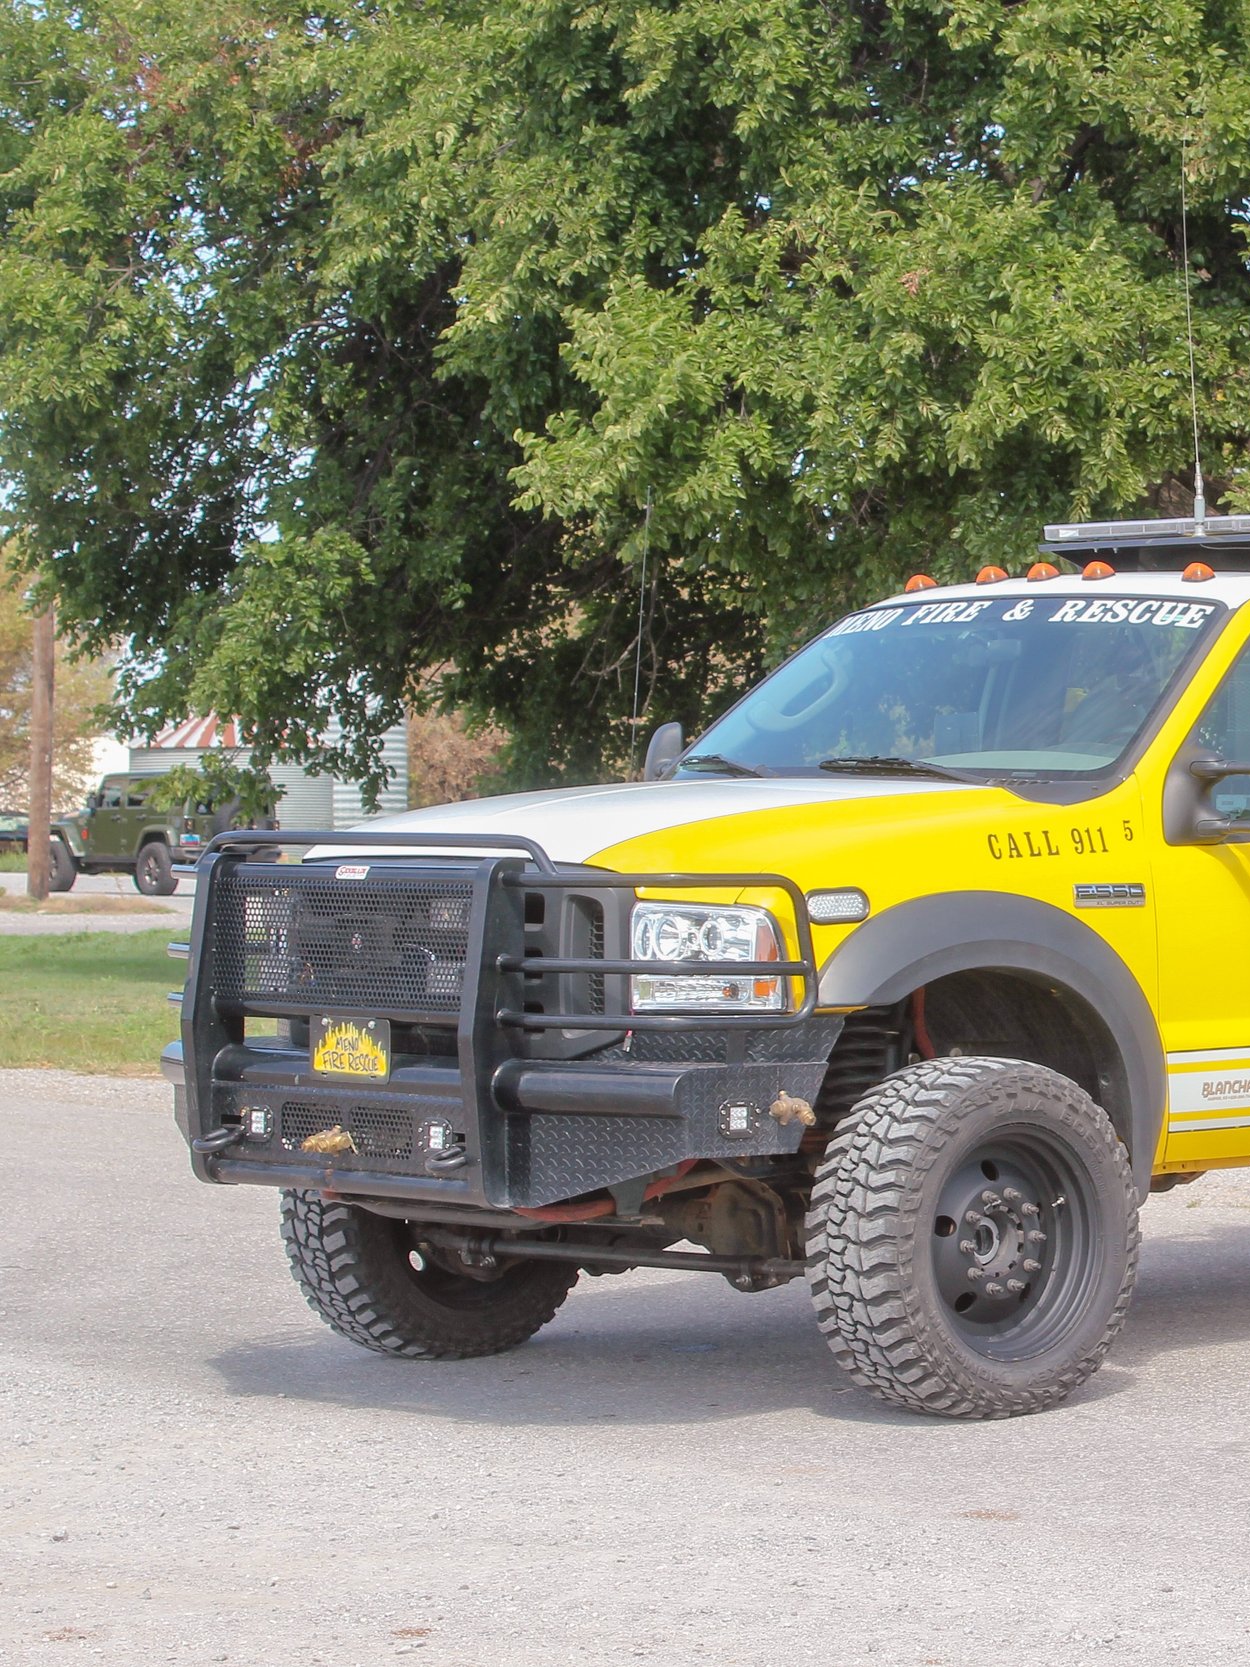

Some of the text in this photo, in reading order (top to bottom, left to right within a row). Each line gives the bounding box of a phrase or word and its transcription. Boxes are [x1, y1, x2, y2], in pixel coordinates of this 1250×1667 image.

[901, 600, 992, 627] FIRE
[1002, 599, 1035, 623] &
[1048, 600, 1214, 629] RESCUE
[1122, 820, 1134, 841] 5
[987, 827, 1109, 860] CALL 911
[335, 1036, 360, 1052] MENO
[321, 1050, 379, 1072] FIRE RESCUE
